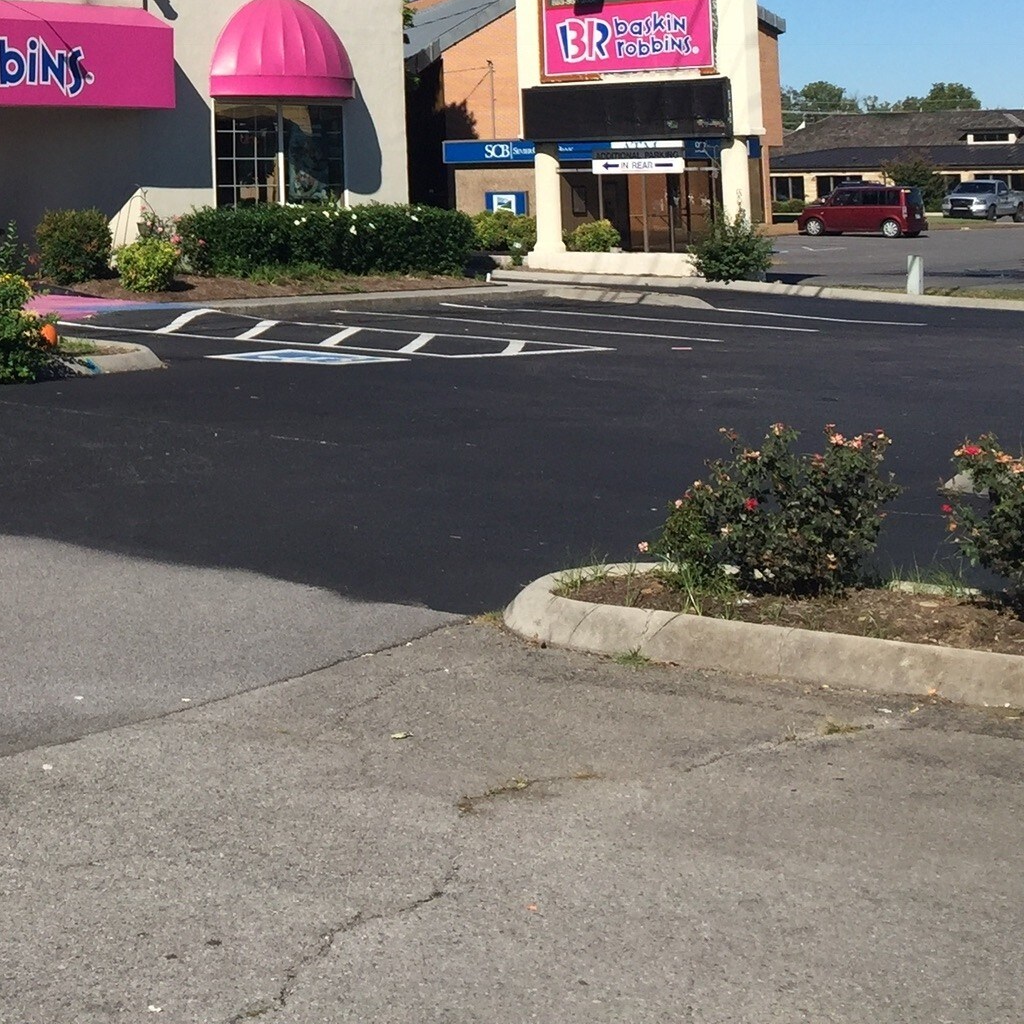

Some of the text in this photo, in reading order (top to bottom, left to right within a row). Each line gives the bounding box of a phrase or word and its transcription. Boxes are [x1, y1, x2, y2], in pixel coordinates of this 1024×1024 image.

[556, 10, 687, 63] BR baskin
[615, 34, 693, 58] robbins
[484, 144, 510, 159] SCB
[596, 150, 678, 159] ADDITIONAL PARKING
[631, 161, 653, 169] REAR
